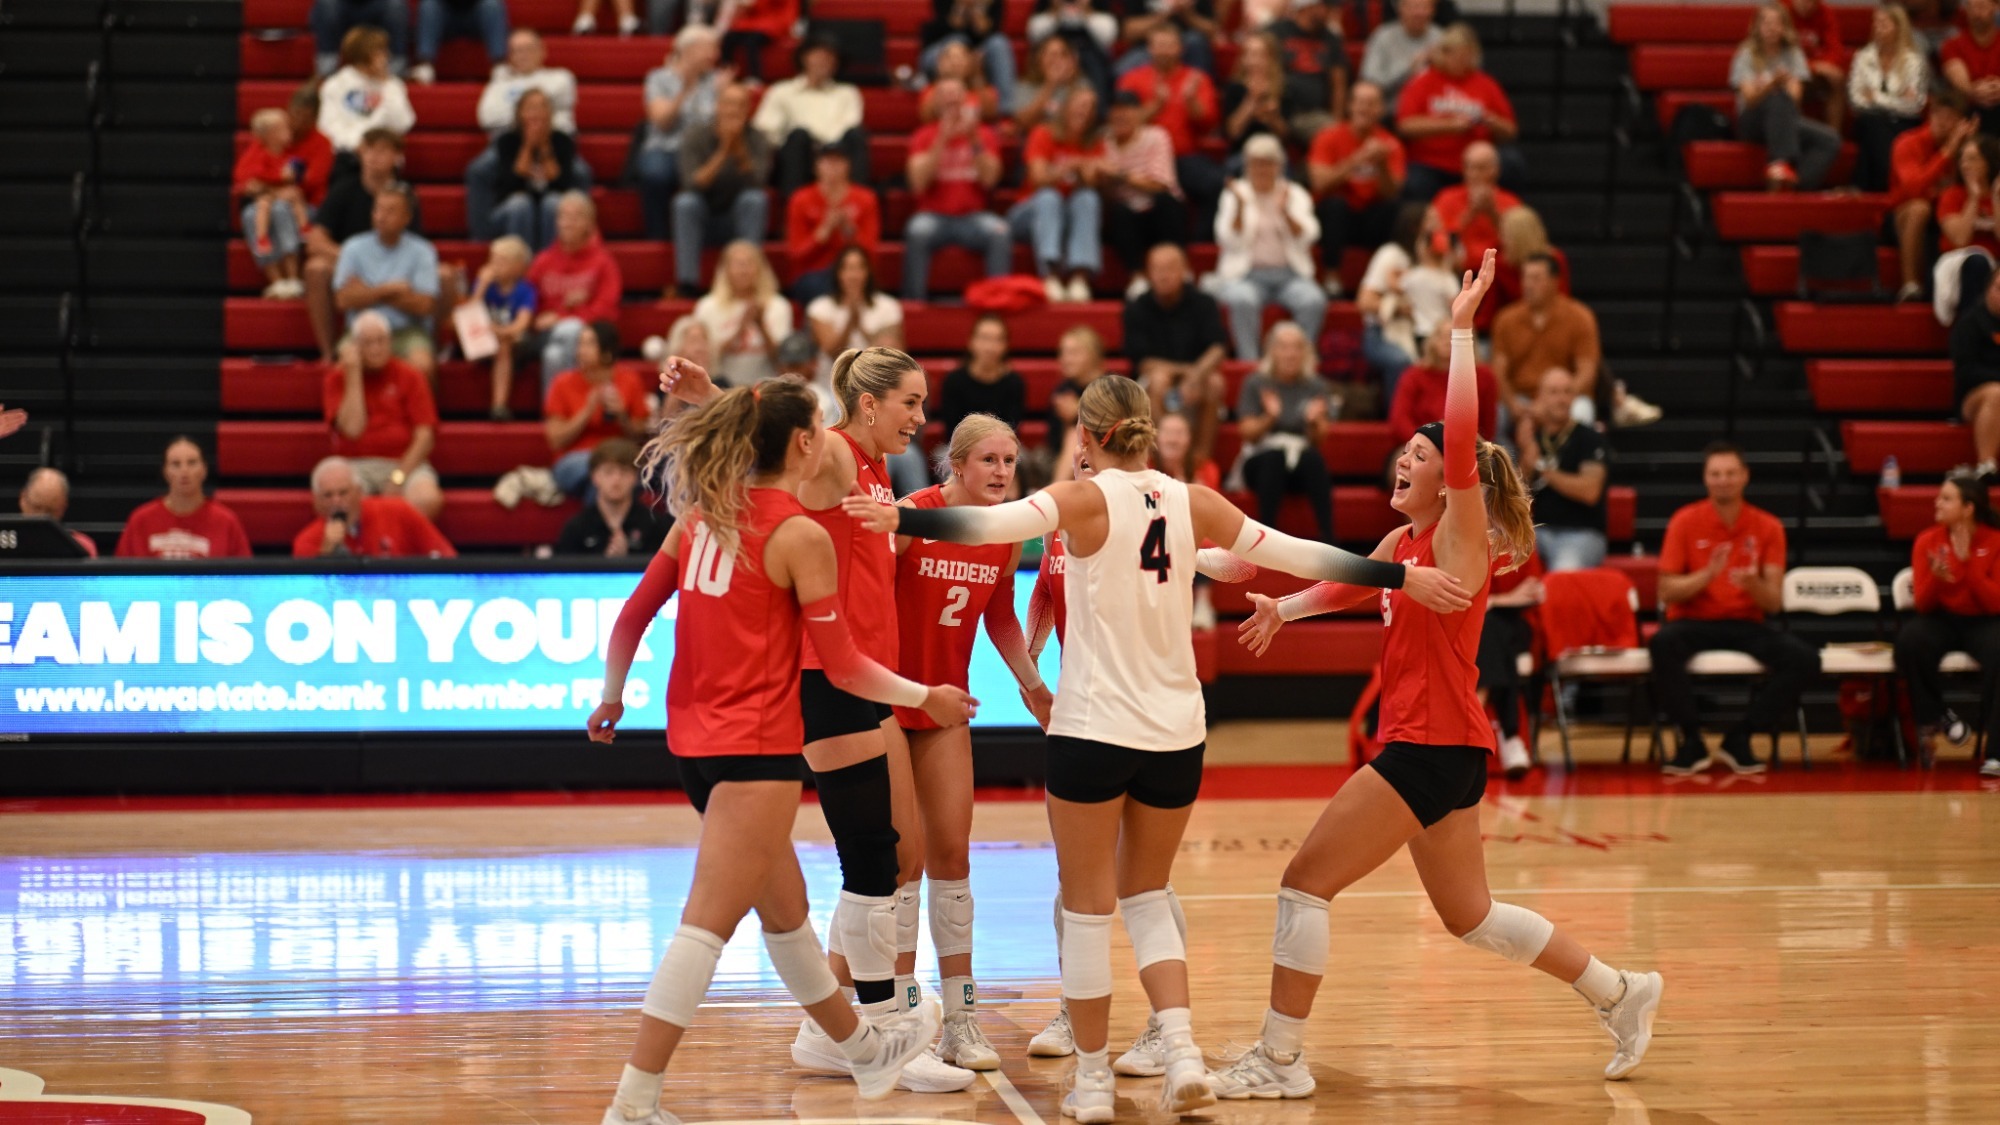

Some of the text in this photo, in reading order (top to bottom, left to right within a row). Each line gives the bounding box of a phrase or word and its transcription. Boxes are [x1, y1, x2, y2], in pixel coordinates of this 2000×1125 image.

[683, 520, 741, 598] 10
[918, 557, 999, 585] RAIDERS
[1139, 515, 1171, 584] 4
[174, 600, 254, 665] IS
[265, 599, 397, 665] ON
[938, 585, 970, 627] 2
[421, 679, 568, 710] Member
[571, 678, 650, 710] FC
